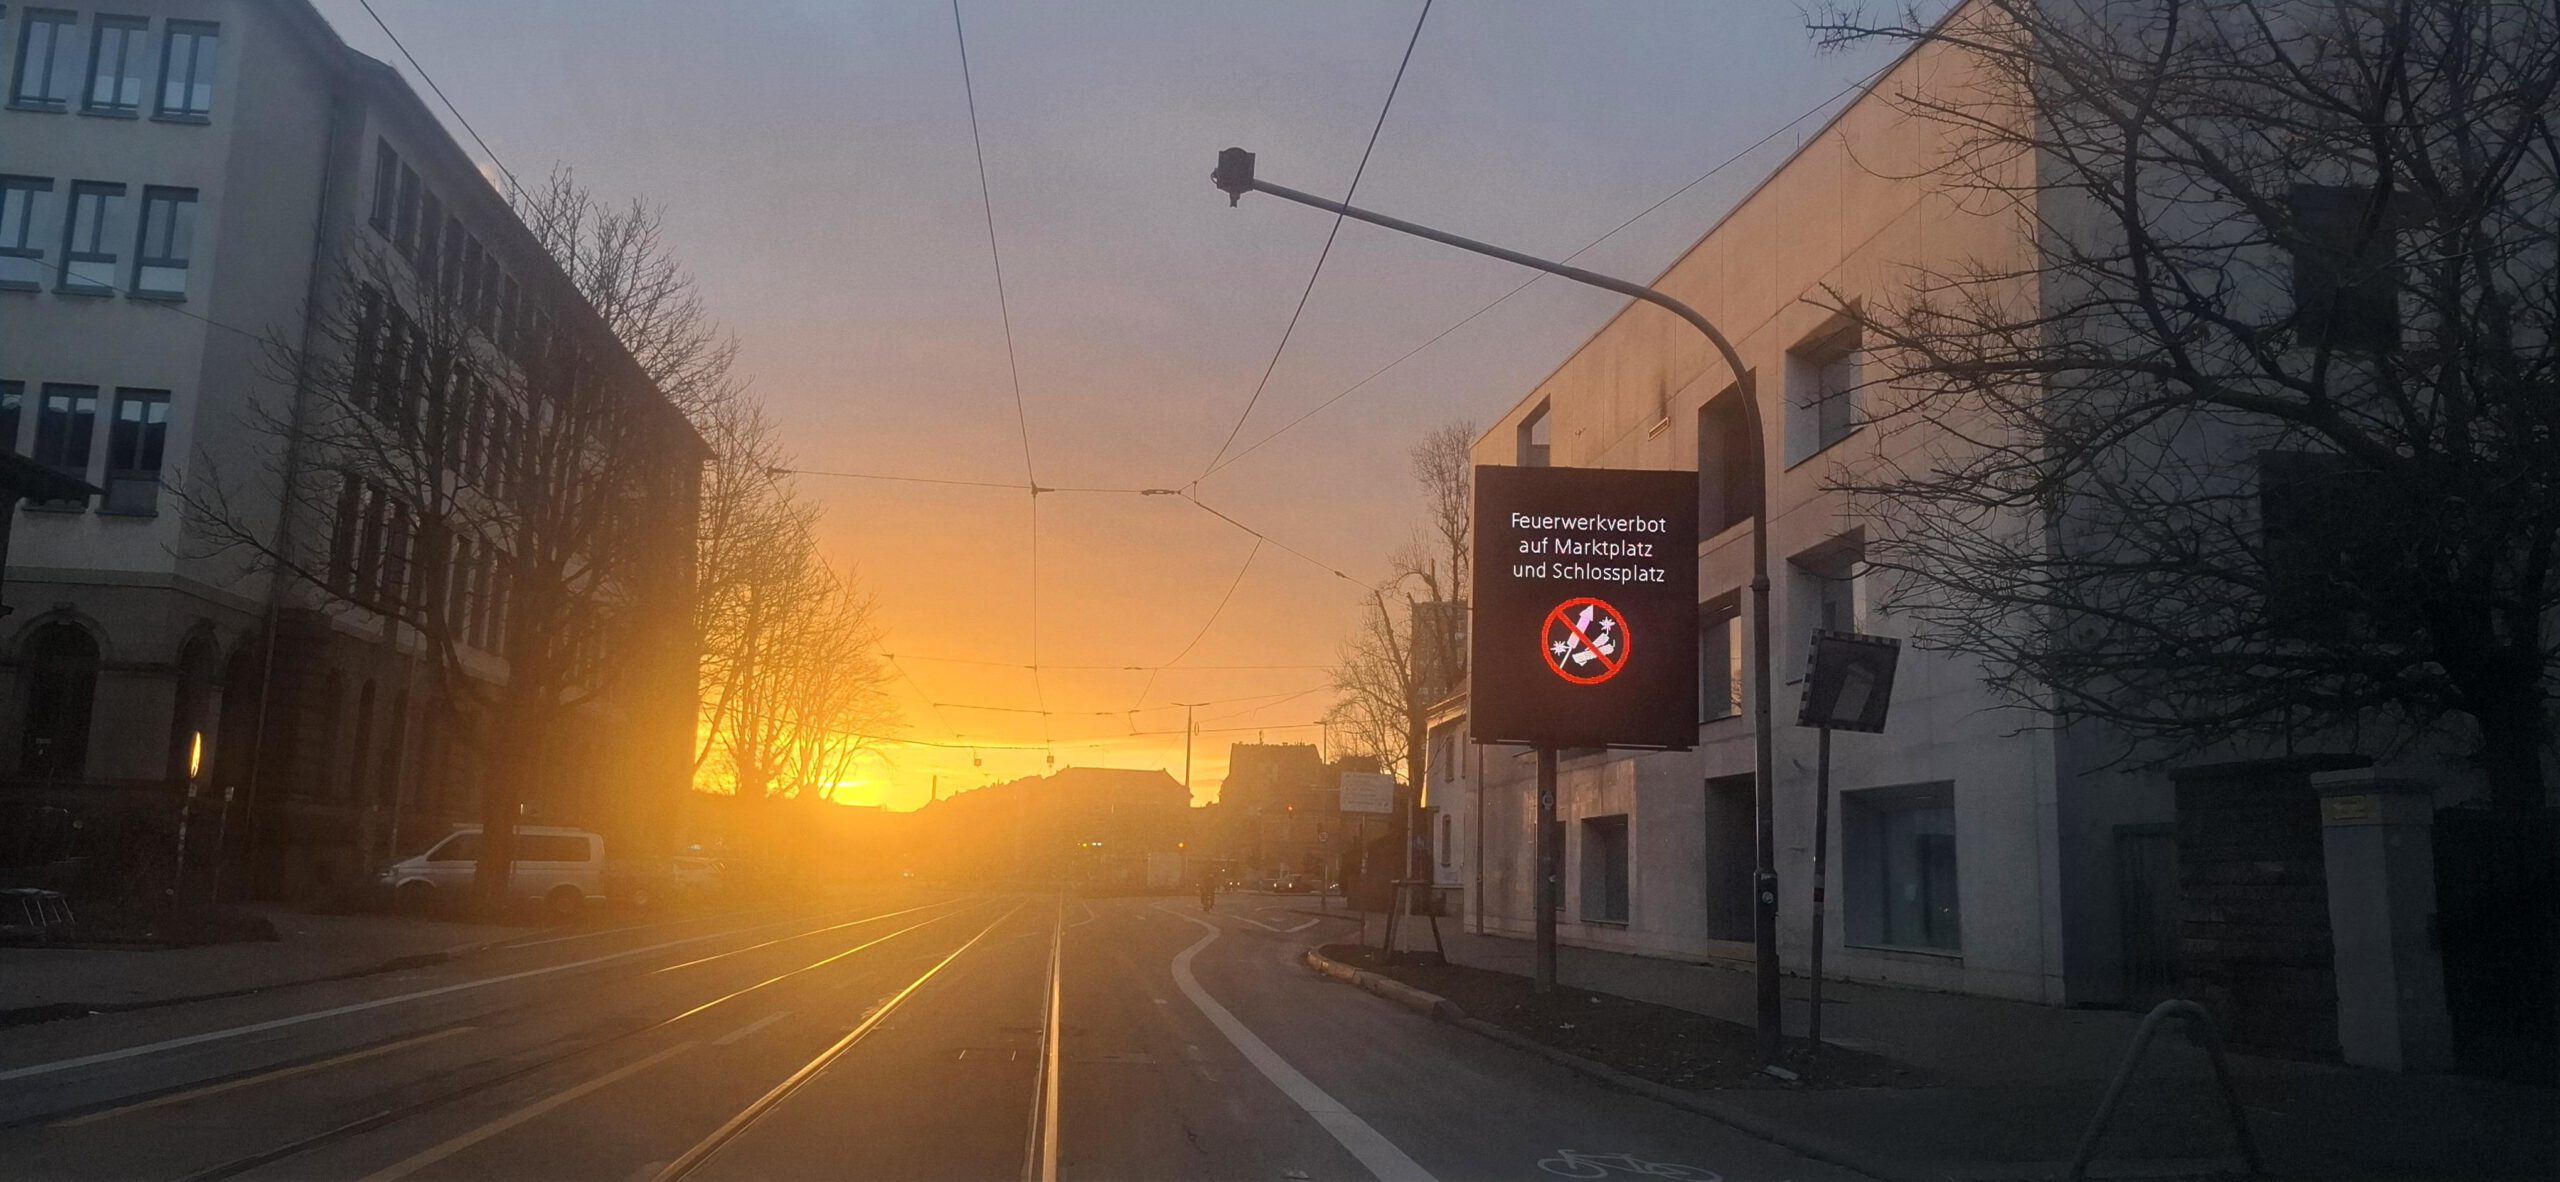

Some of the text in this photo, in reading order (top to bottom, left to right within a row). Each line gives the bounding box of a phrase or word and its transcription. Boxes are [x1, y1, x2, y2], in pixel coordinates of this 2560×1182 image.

[1511, 513, 1667, 533] Feuerwerkverbot
[1519, 537, 1653, 560] auf Marktplatz
[1513, 562, 1665, 585] und Schlossplatz
